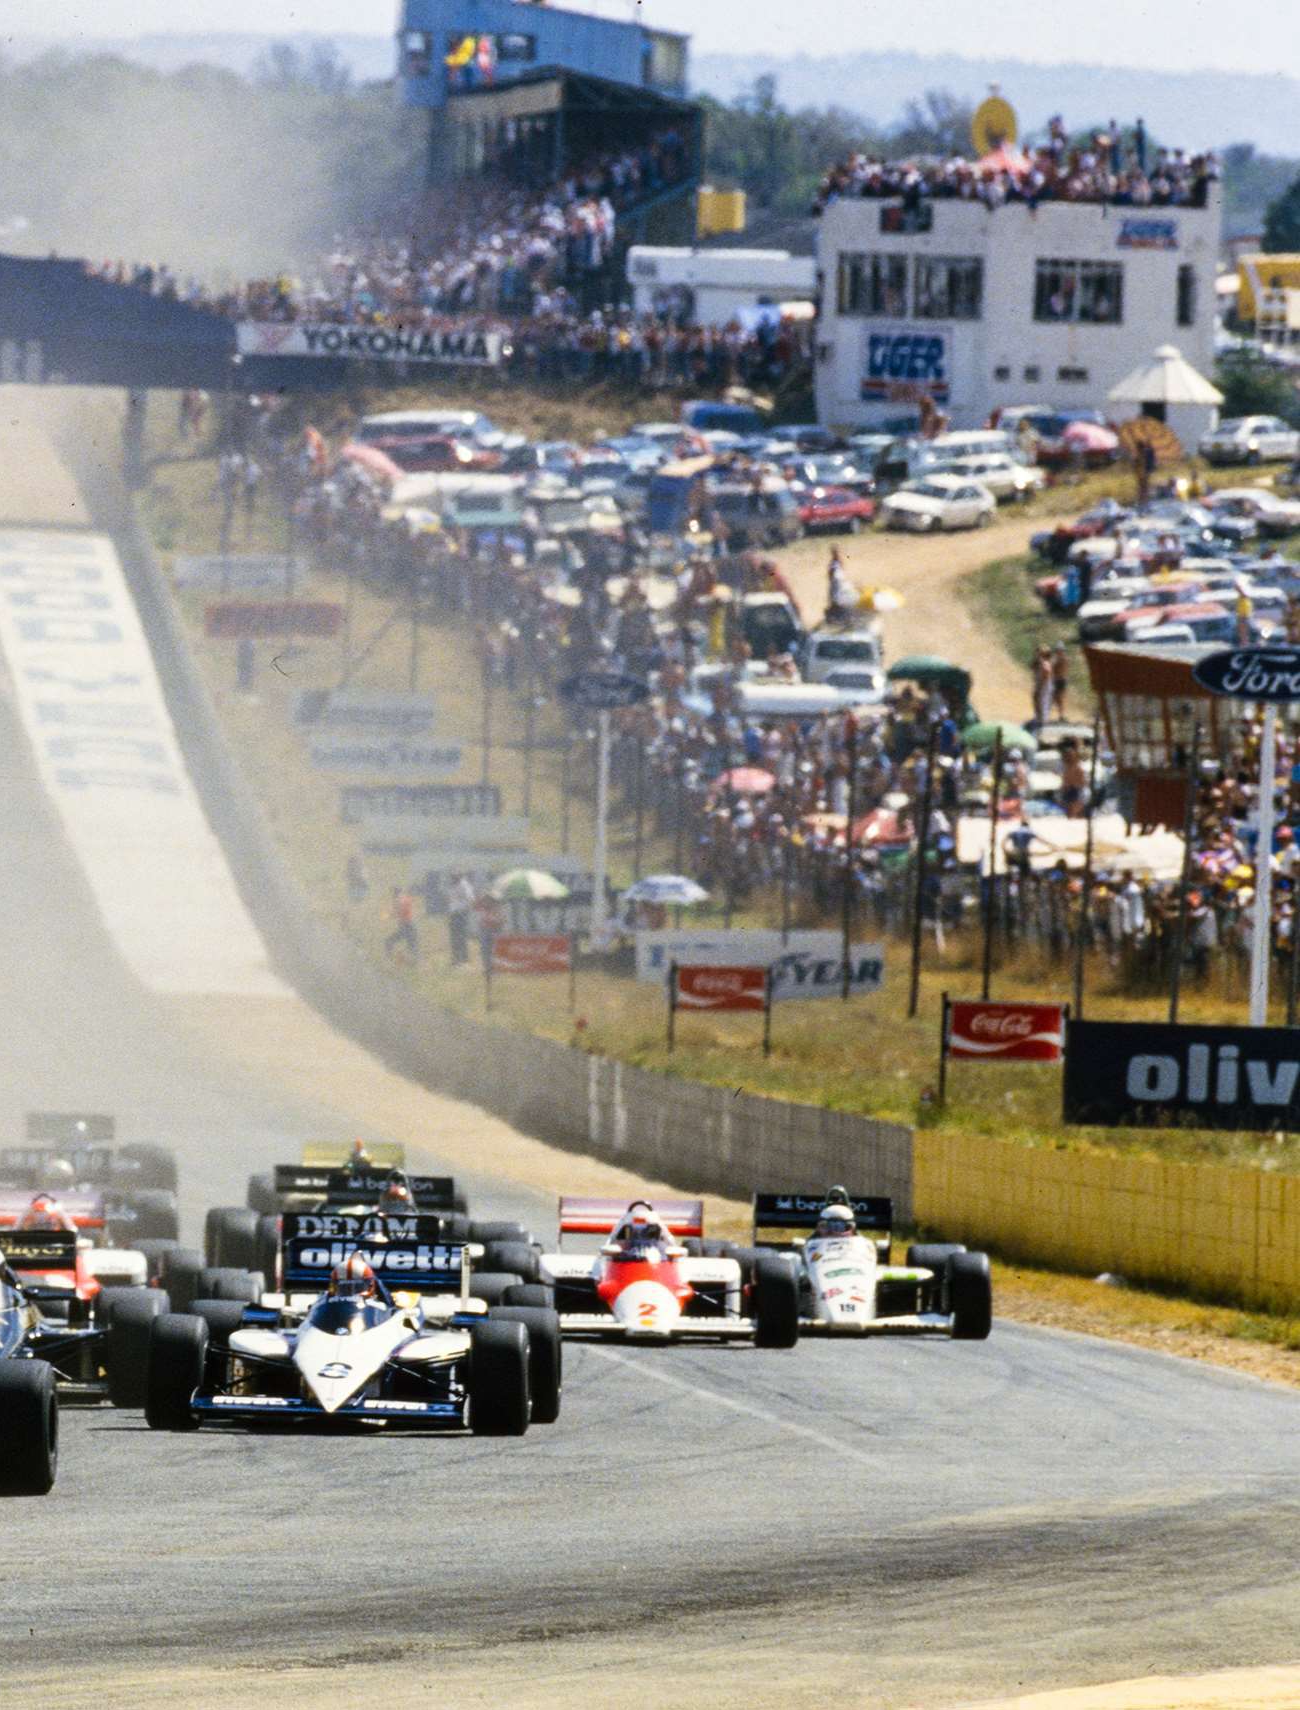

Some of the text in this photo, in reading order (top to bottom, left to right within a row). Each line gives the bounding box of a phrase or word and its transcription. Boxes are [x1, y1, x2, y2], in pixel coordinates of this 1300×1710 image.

[304, 331, 488, 357] YOKOHAMA
[300, 1242, 461, 1271] olivetti
[638, 1303, 658, 1317] 2
